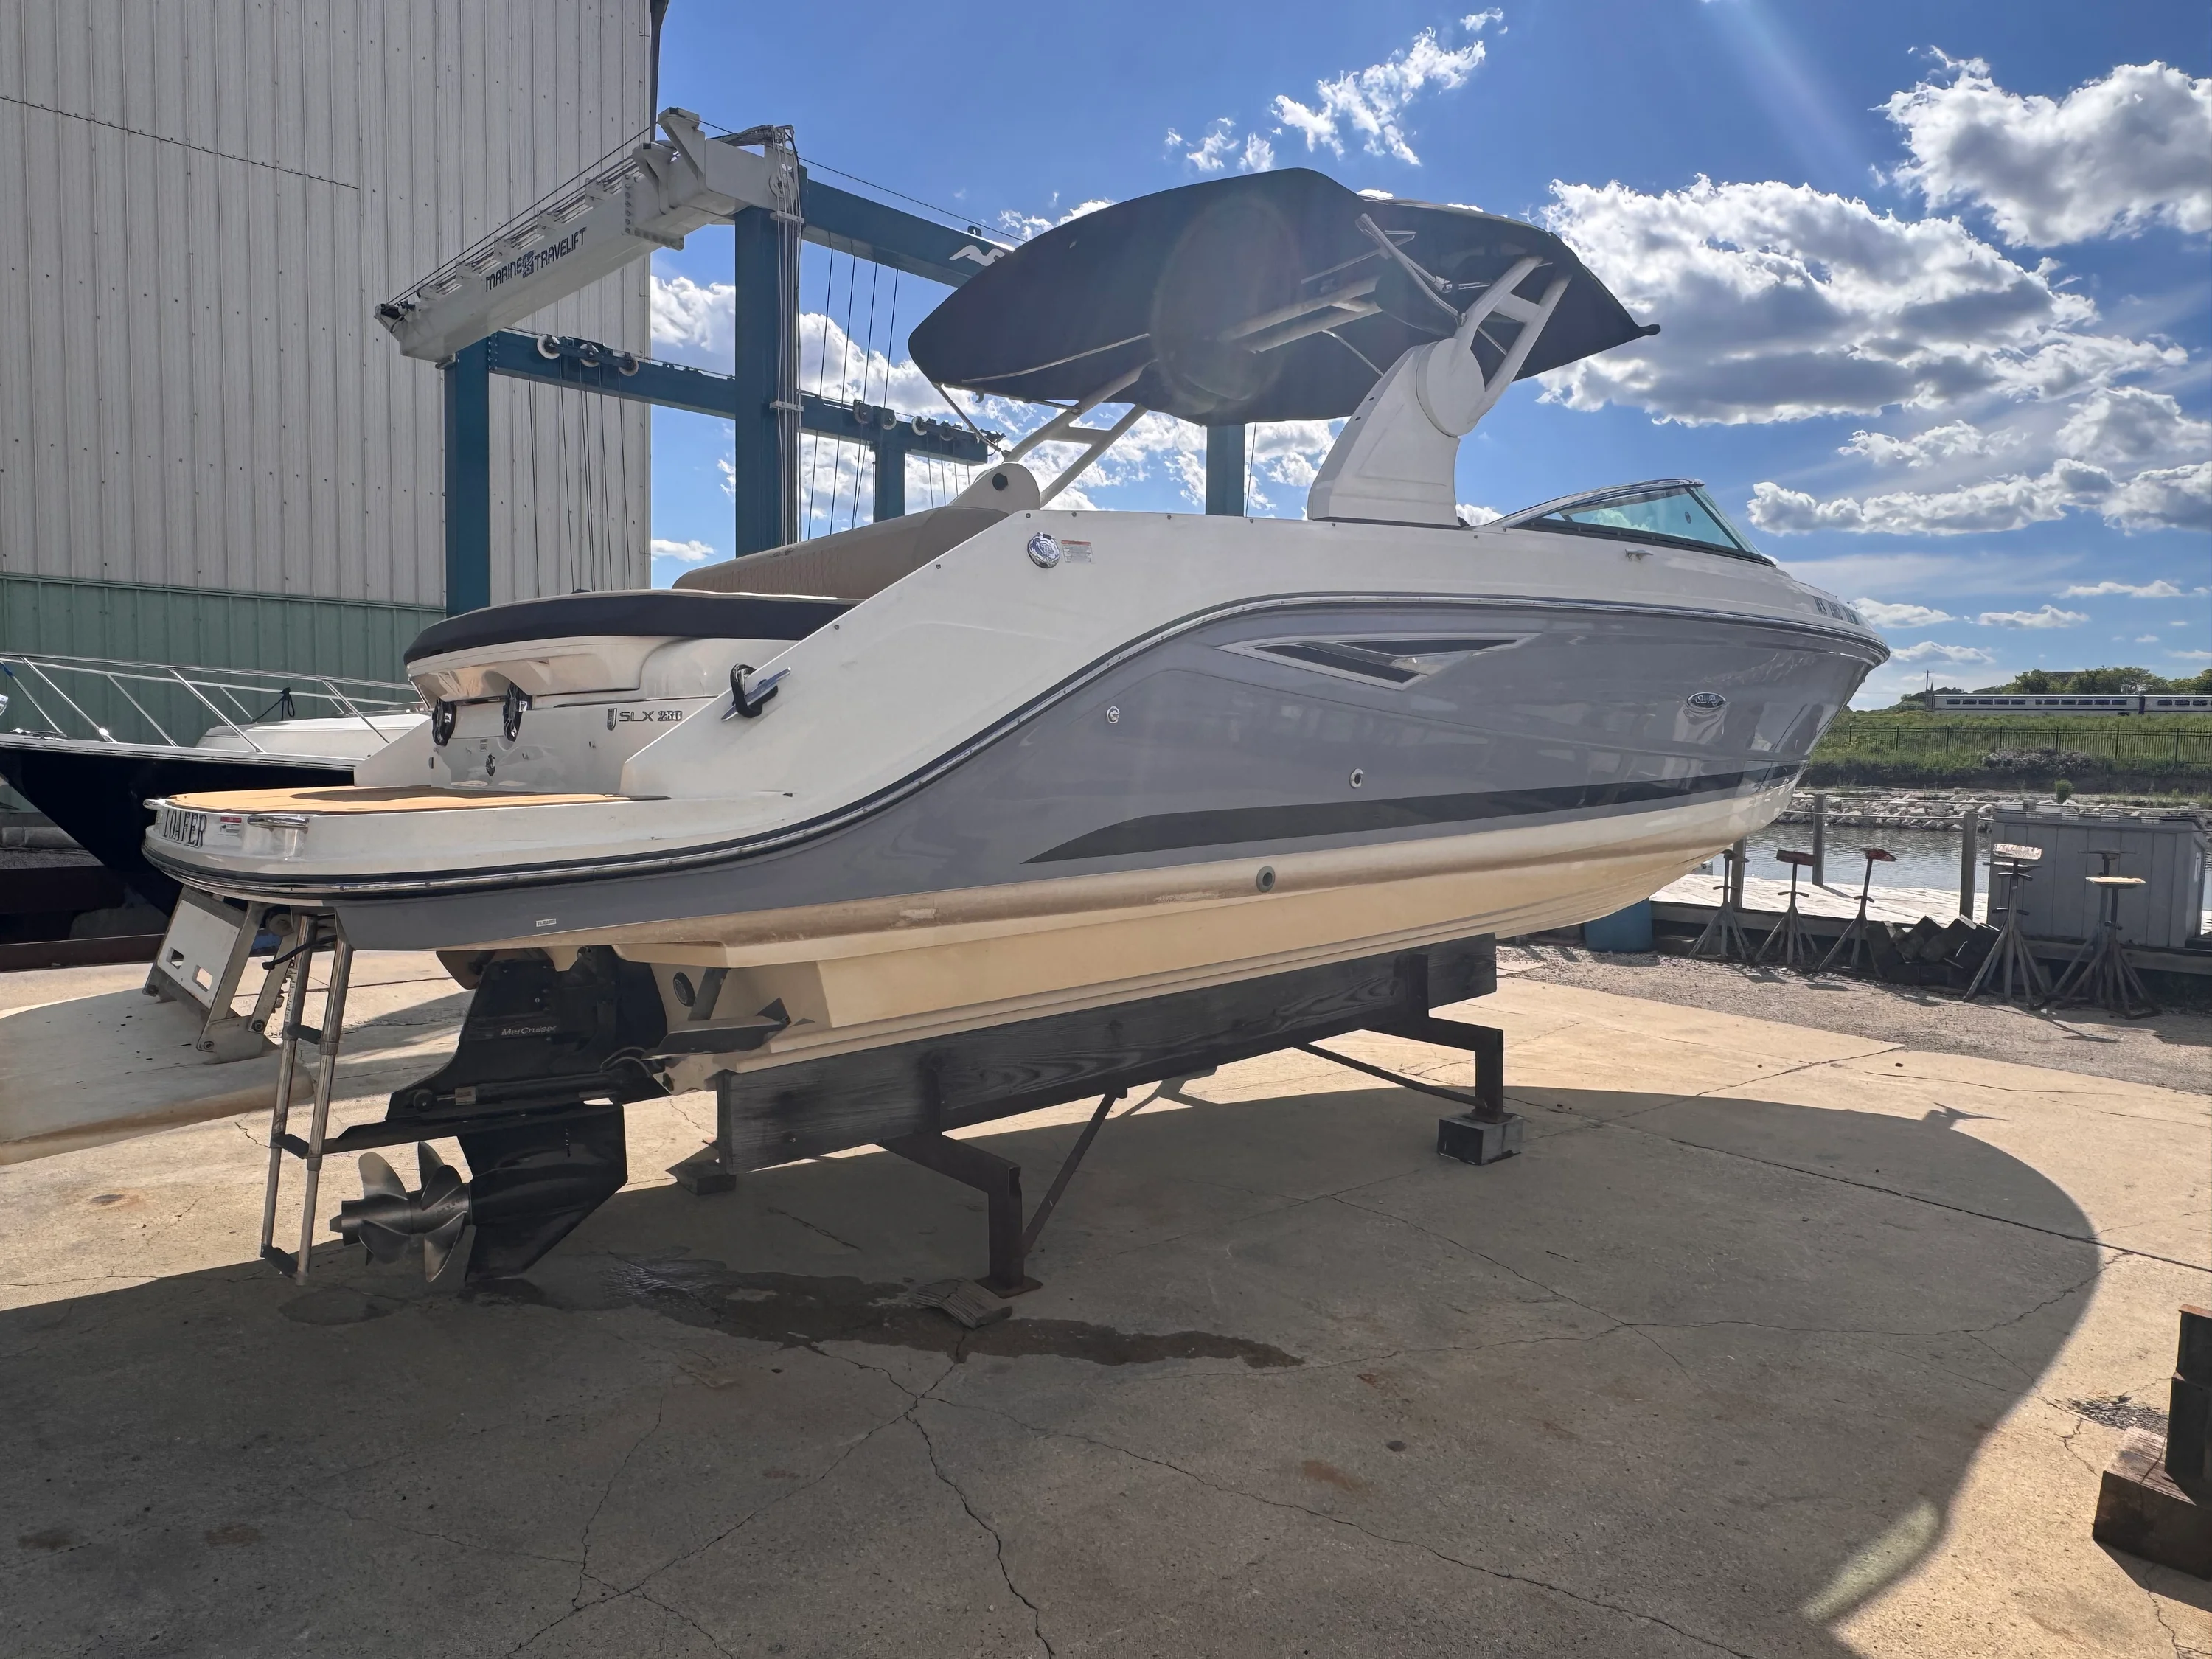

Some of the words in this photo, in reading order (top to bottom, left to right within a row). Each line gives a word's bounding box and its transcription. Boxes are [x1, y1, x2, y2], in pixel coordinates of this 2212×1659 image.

[485, 257, 524, 292] MARINE
[534, 226, 587, 271] TRAVELIFT
[619, 710, 655, 722] SLX
[163, 809, 207, 848] LOAFER
